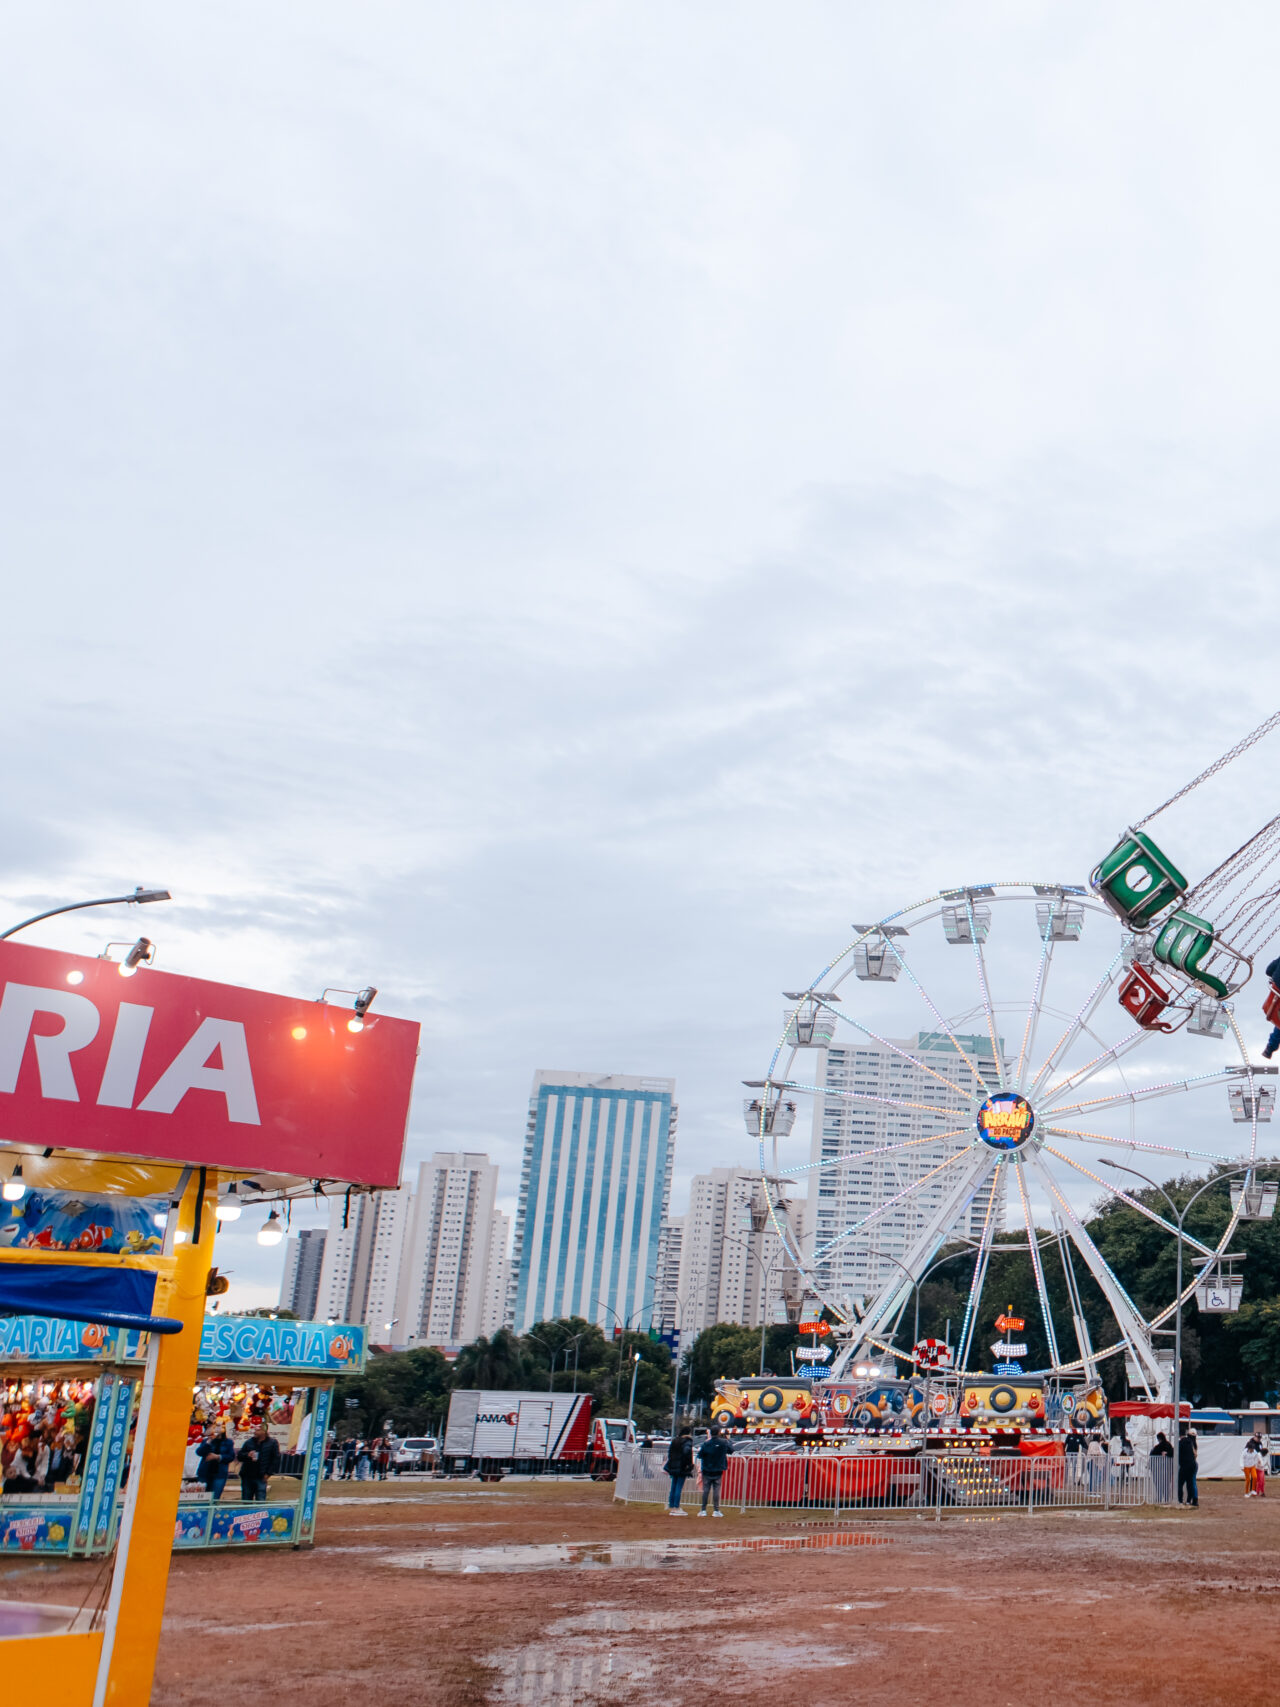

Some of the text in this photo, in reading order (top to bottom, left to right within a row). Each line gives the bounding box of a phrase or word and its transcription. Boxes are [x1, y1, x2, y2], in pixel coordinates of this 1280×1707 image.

[79, 1387, 111, 1530] PESCARIA
[97, 1387, 129, 1530] PESCARIA
[302, 1393, 328, 1520] PESCARIA
